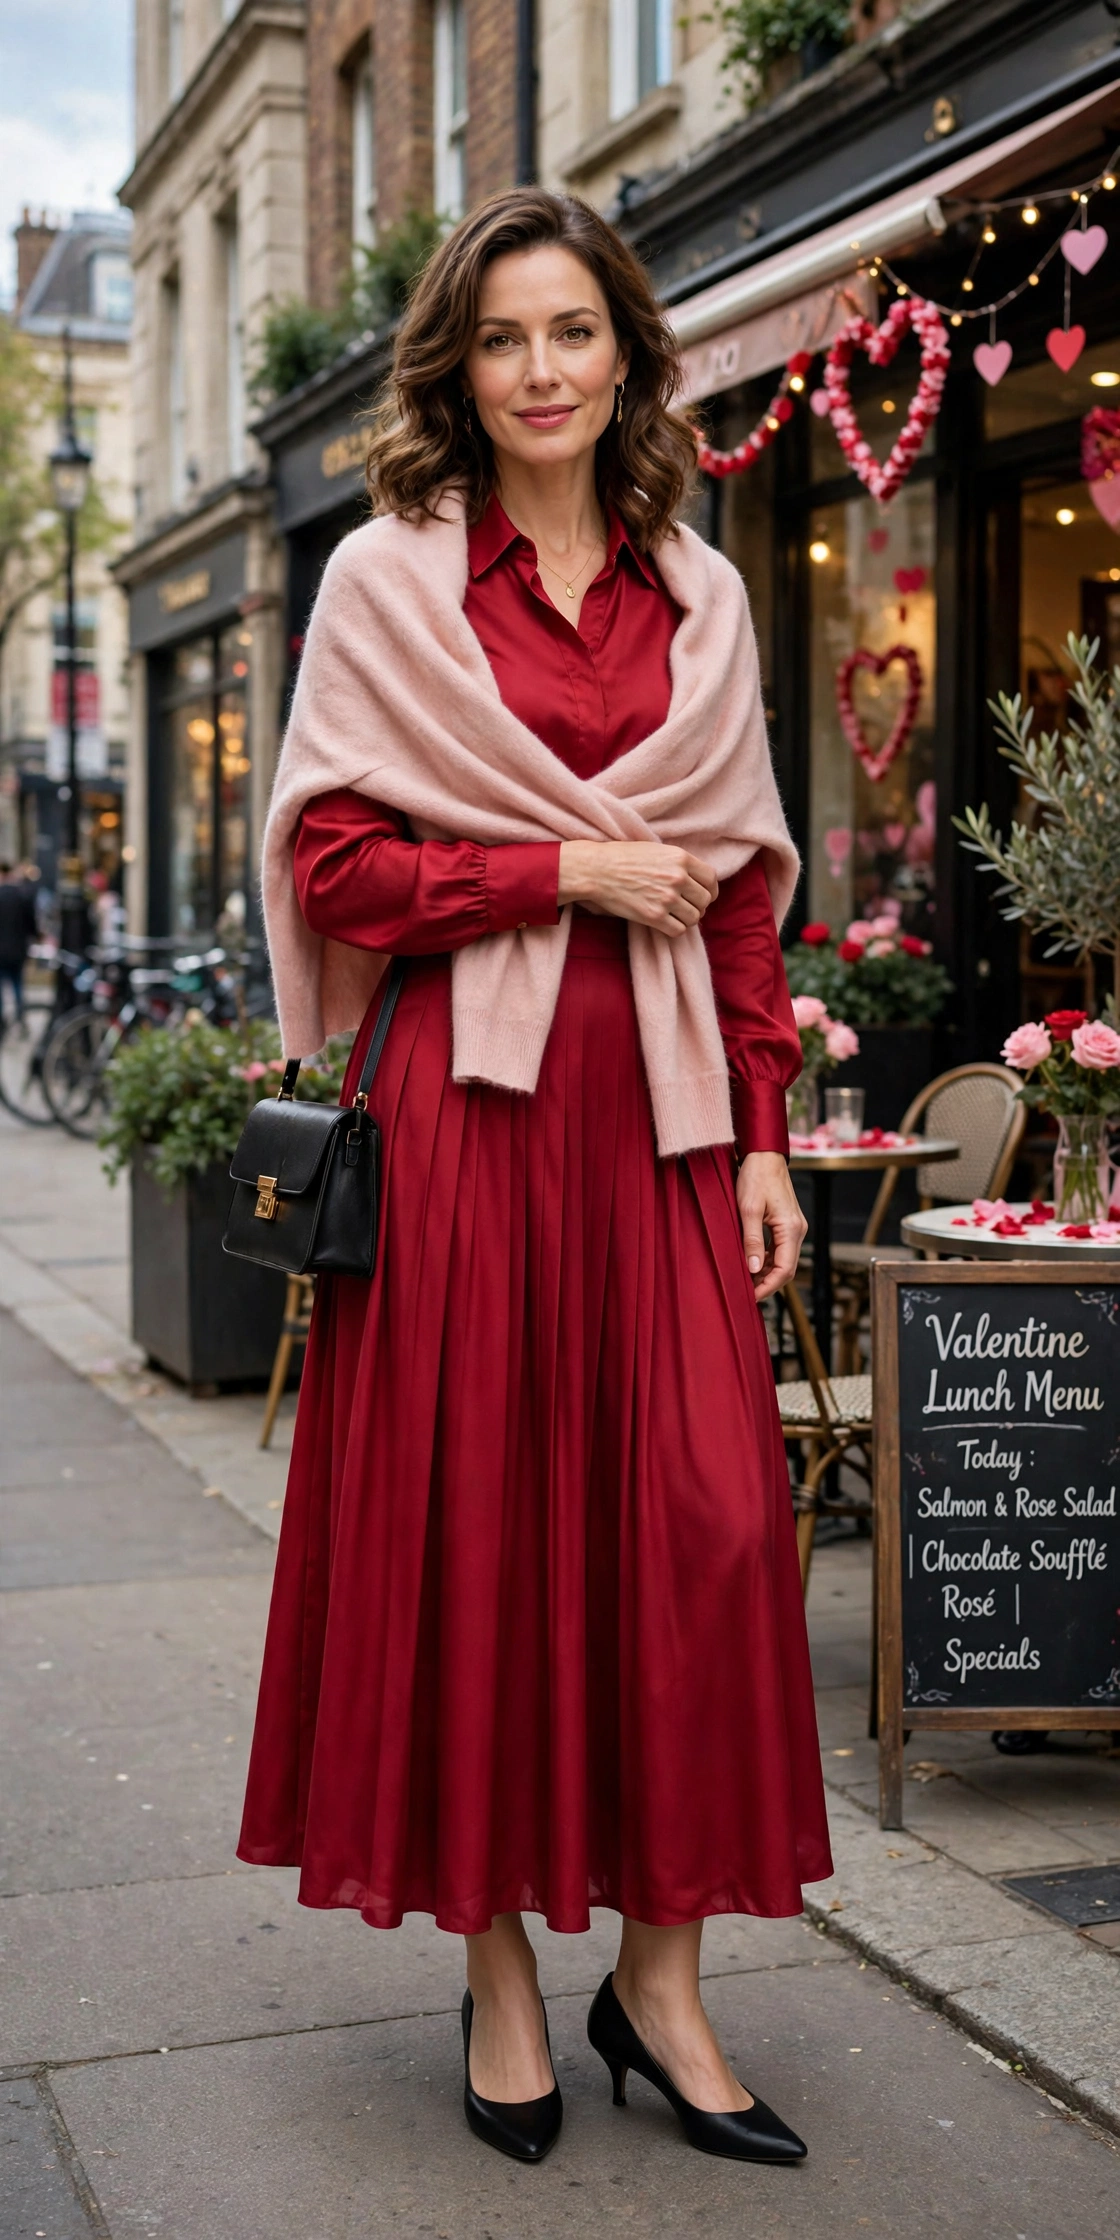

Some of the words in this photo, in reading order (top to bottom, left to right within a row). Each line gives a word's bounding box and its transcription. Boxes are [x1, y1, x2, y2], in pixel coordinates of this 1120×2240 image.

[924, 1311, 1090, 1362] Valentine
[922, 1368, 1016, 1415] Lunch
[1024, 1369, 1105, 1418] Menu
[956, 1438, 1023, 1481] Today
[917, 1486, 988, 1519] Salmon
[993, 1490, 1009, 1518] &
[1015, 1486, 1057, 1519] Rose
[1063, 1485, 1117, 1518] Salad
[922, 1538, 1022, 1573] Chocolate
[1029, 1538, 1108, 1581] Soufflé
[941, 1584, 996, 1619] Rosé
[943, 1636, 1041, 1684] Specials
